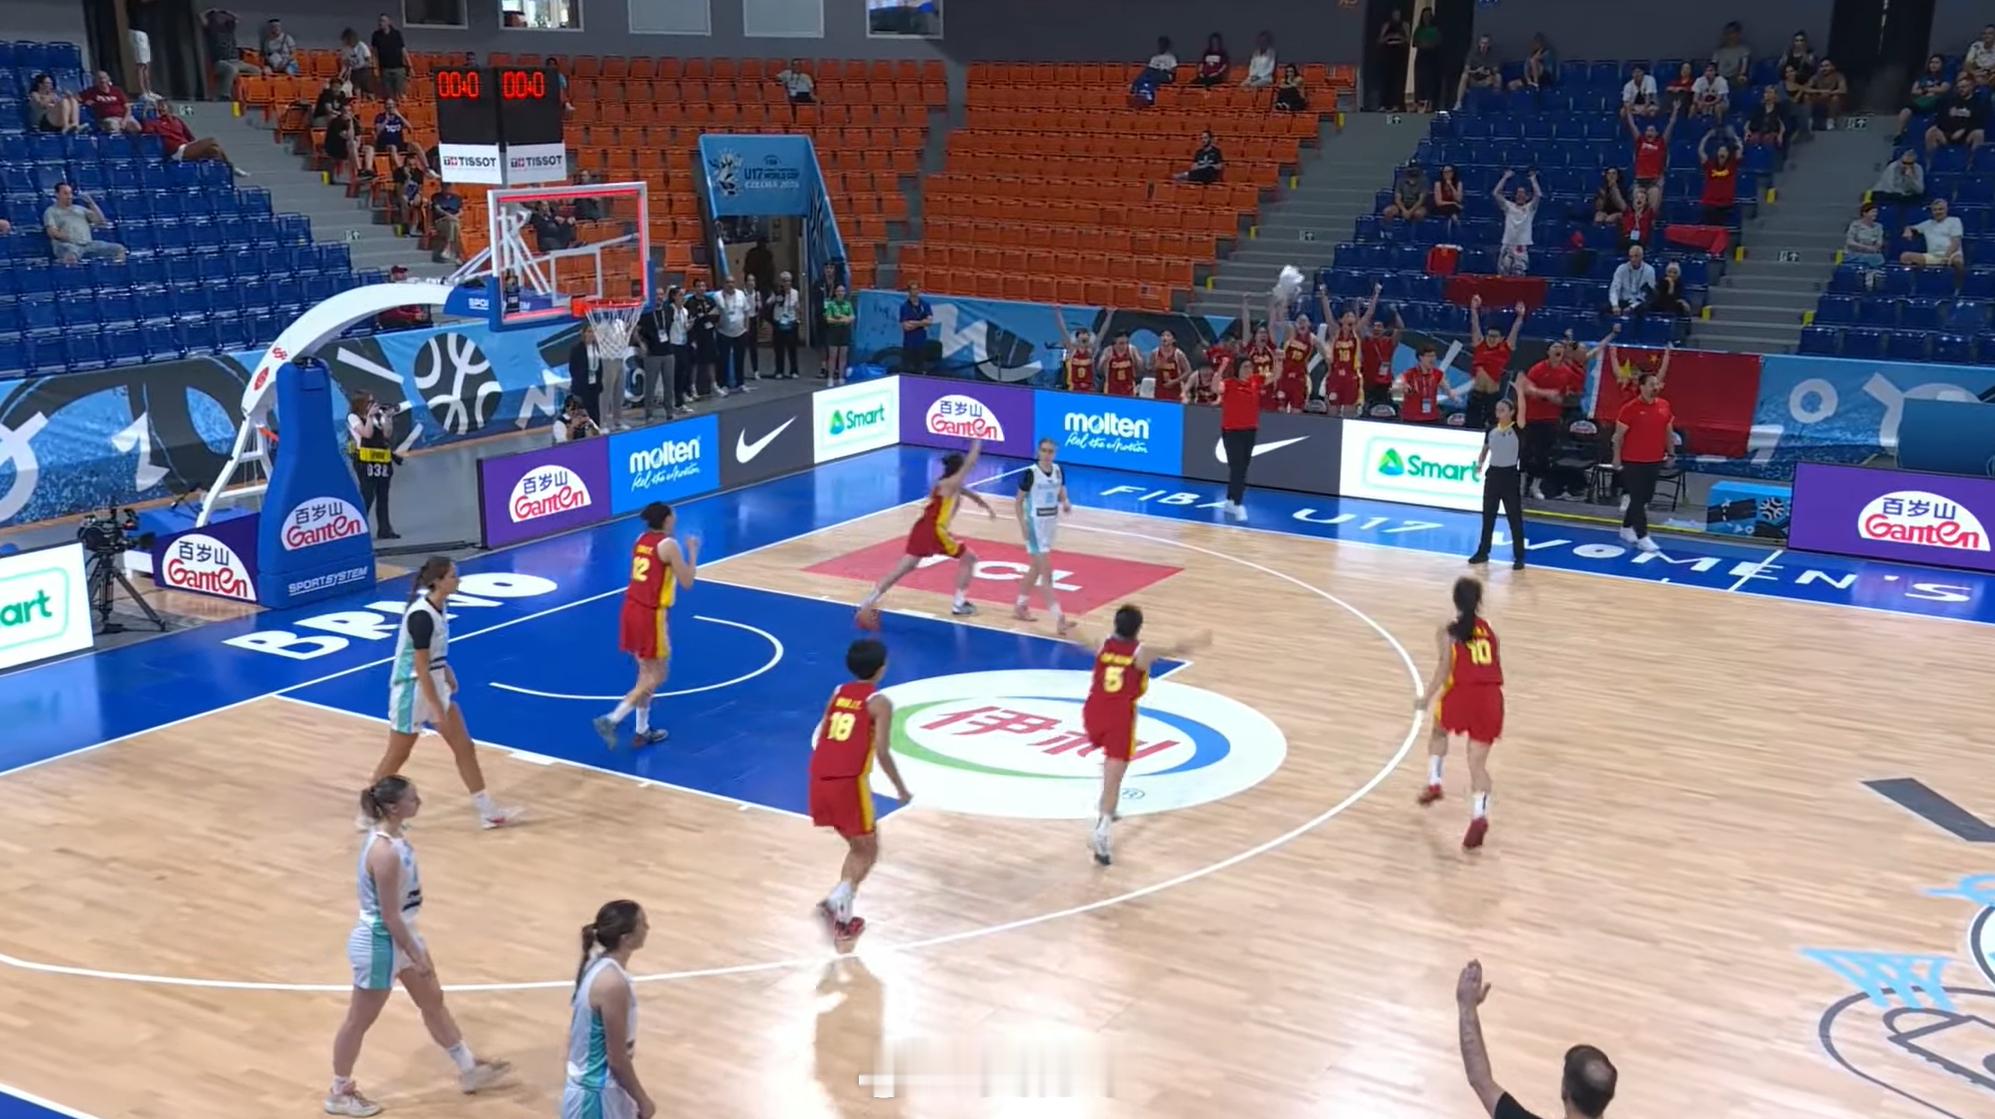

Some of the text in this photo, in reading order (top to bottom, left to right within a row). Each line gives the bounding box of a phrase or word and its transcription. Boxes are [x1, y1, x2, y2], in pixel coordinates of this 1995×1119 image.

[458, 156, 497, 167] TISSOT
[526, 155, 563, 167] TISSOT
[744, 168, 763, 180] U17
[846, 404, 886, 430] Smart
[939, 400, 983, 417] 百岁山
[1064, 411, 1150, 440] molten
[629, 438, 700, 474] molten
[1407, 454, 1481, 483] Smart
[523, 470, 568, 495] 百岁山
[296, 502, 343, 525] 百岁山
[1292, 508, 1445, 533] U17
[1883, 497, 1957, 520] 百岁山
[179, 540, 230, 567] 百岁山
[288, 566, 369, 594] SPORTSYSTEM
[1466, 638, 1492, 665] 10
[1103, 666, 1124, 693] 5
[827, 711, 856, 742] 18
